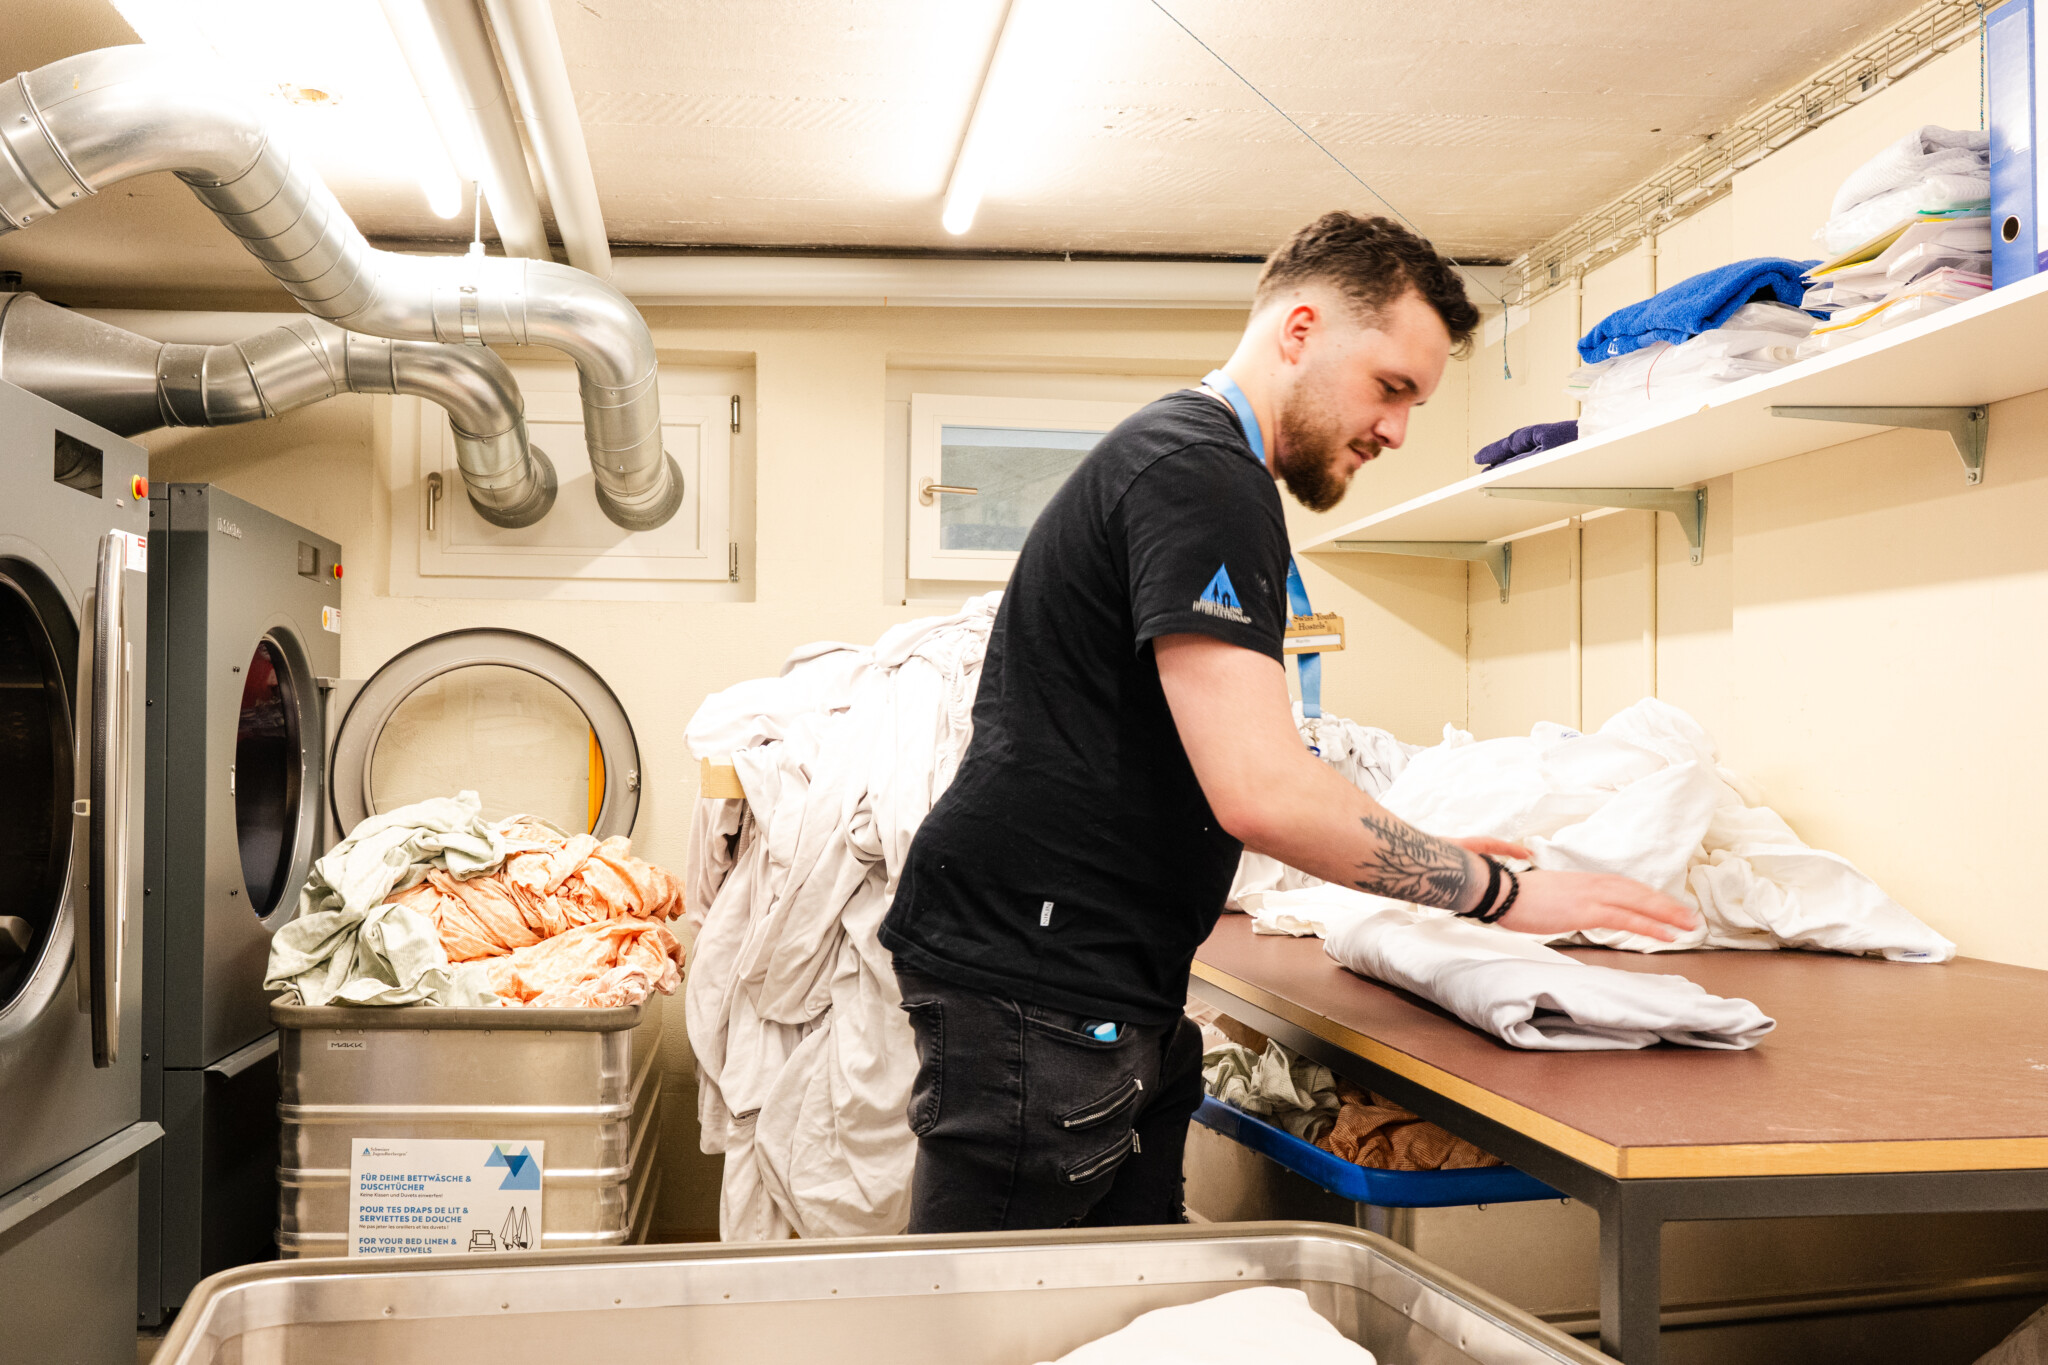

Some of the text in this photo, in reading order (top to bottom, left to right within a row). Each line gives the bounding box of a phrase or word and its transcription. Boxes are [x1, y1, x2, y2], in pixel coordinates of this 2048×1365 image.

[1315, 612, 1337, 620] Youth
[360, 1173, 377, 1181] FÜR
[407, 1174, 463, 1182] BETTWÄSCHE
[360, 1182, 424, 1190] DUSCHTÜCHER
